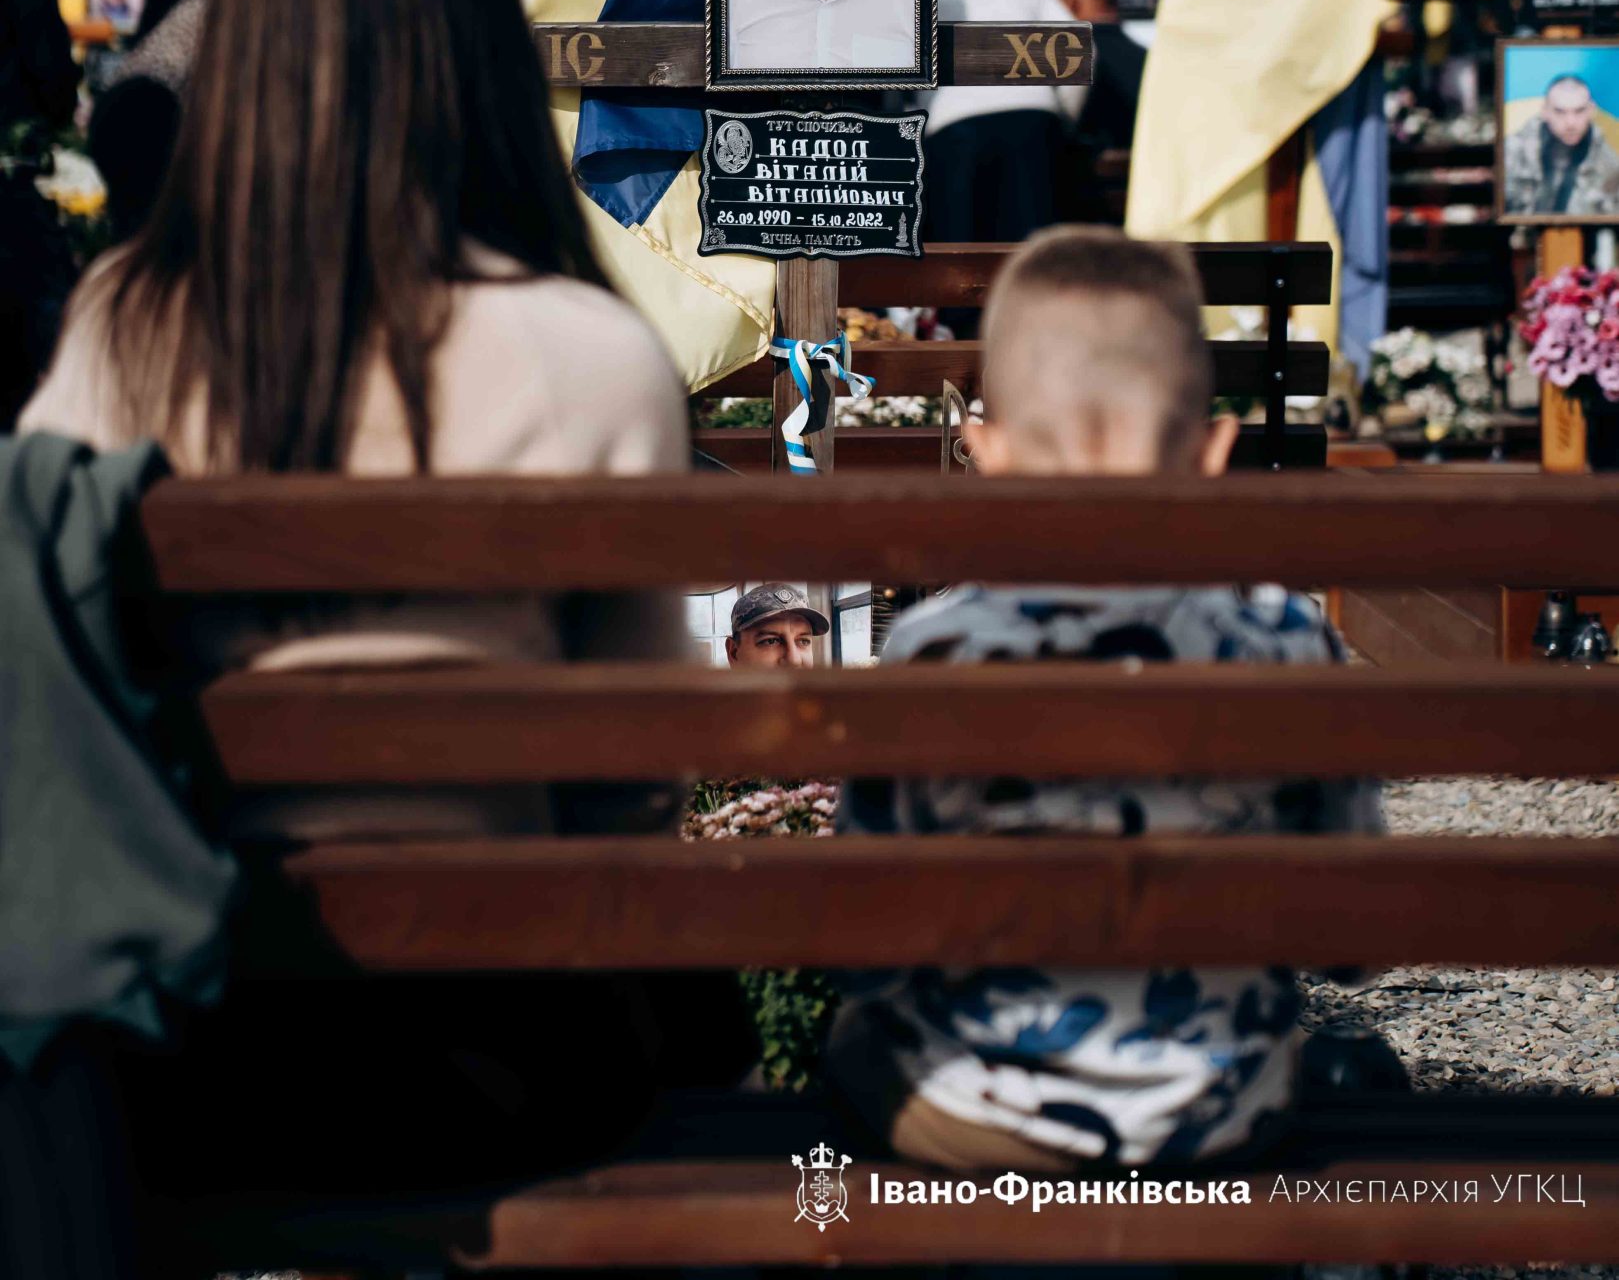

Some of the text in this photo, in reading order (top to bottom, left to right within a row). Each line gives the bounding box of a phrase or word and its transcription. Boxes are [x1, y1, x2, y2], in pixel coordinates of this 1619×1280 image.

[766, 121, 863, 134] ТУТ СПОЧИВАЄ
[769, 137, 870, 159] КАДОЛ
[717, 210, 791, 225] 26.09.1990
[811, 212, 884, 227] 15.10.2022
[760, 232, 802, 245] ВІЧНА
